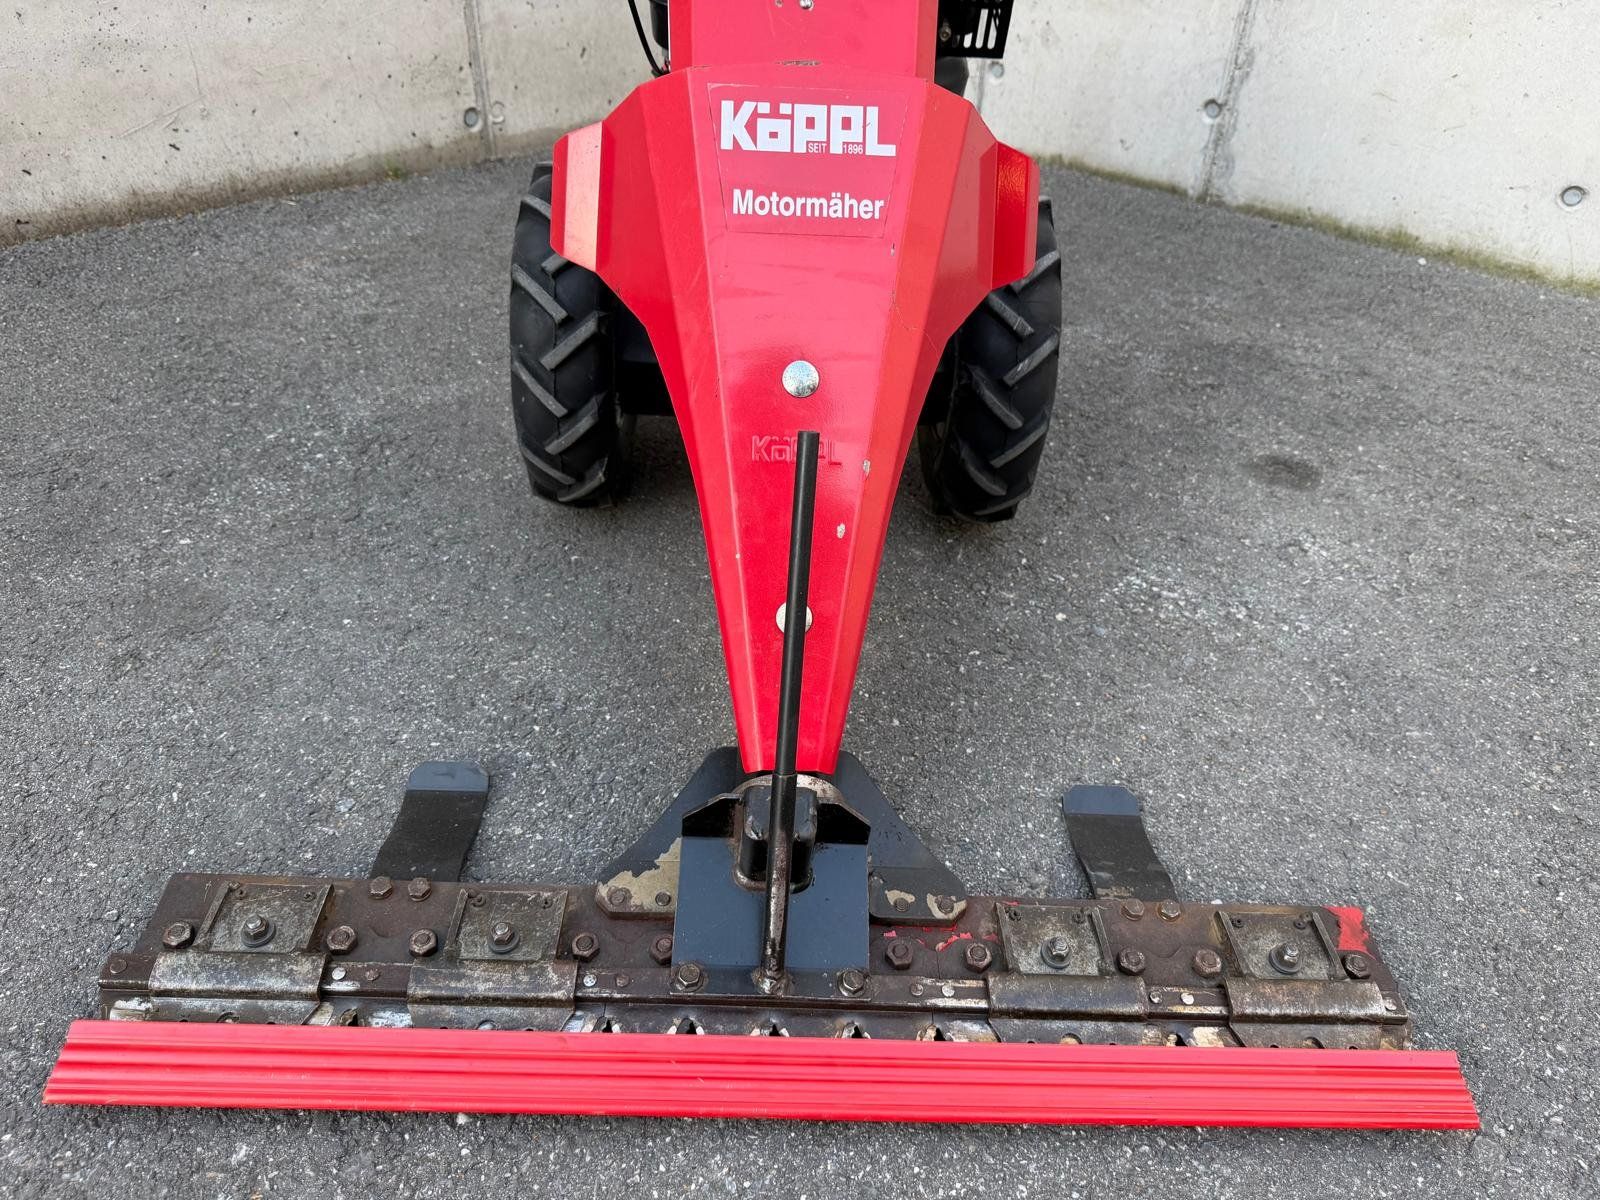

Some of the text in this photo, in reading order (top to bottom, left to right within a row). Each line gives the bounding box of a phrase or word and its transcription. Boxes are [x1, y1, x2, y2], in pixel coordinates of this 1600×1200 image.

[807, 142, 863, 154] SEIT 1896
[732, 188, 884, 219] Motormäher
